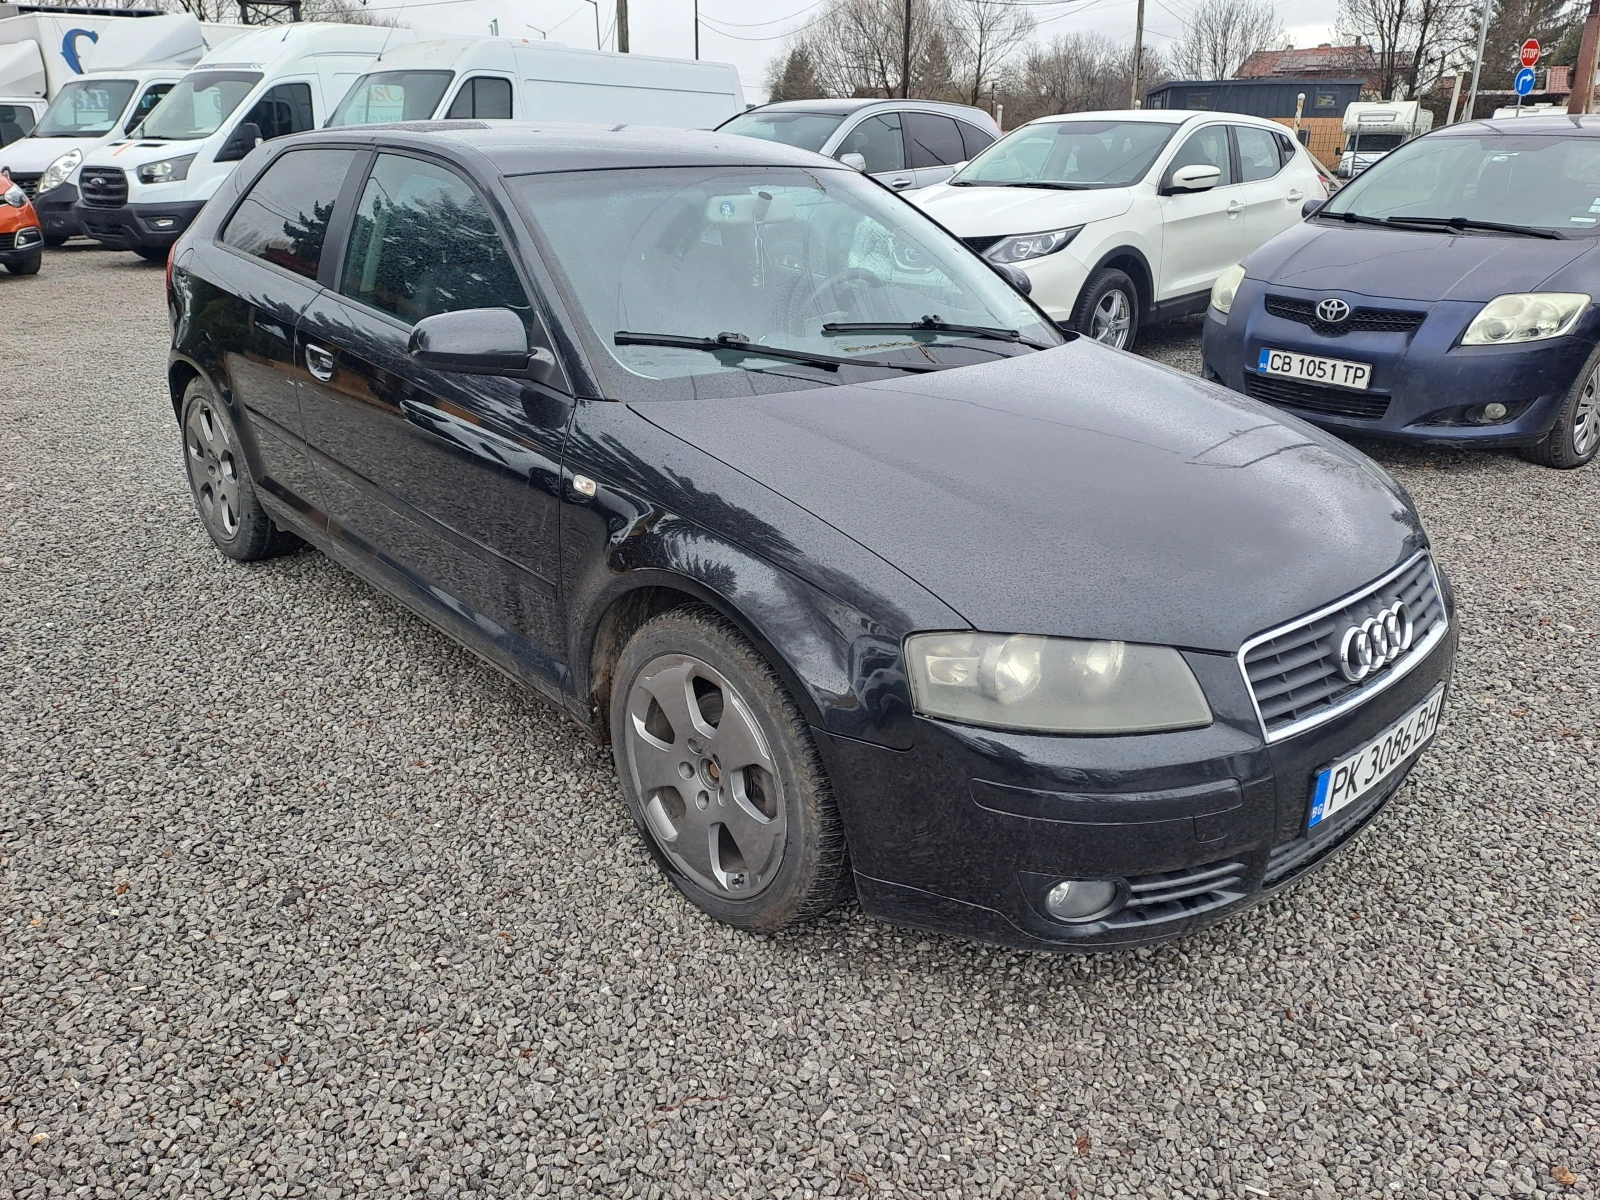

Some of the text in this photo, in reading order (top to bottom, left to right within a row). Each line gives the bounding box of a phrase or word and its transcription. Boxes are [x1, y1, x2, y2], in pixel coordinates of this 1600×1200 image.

[1522, 48, 1538, 58] STOP
[1270, 353, 1292, 373] CB
[1298, 357, 1338, 381] 1051
[1343, 364, 1366, 385] TP
[1311, 693, 1441, 819] BG PK 3086 BH
